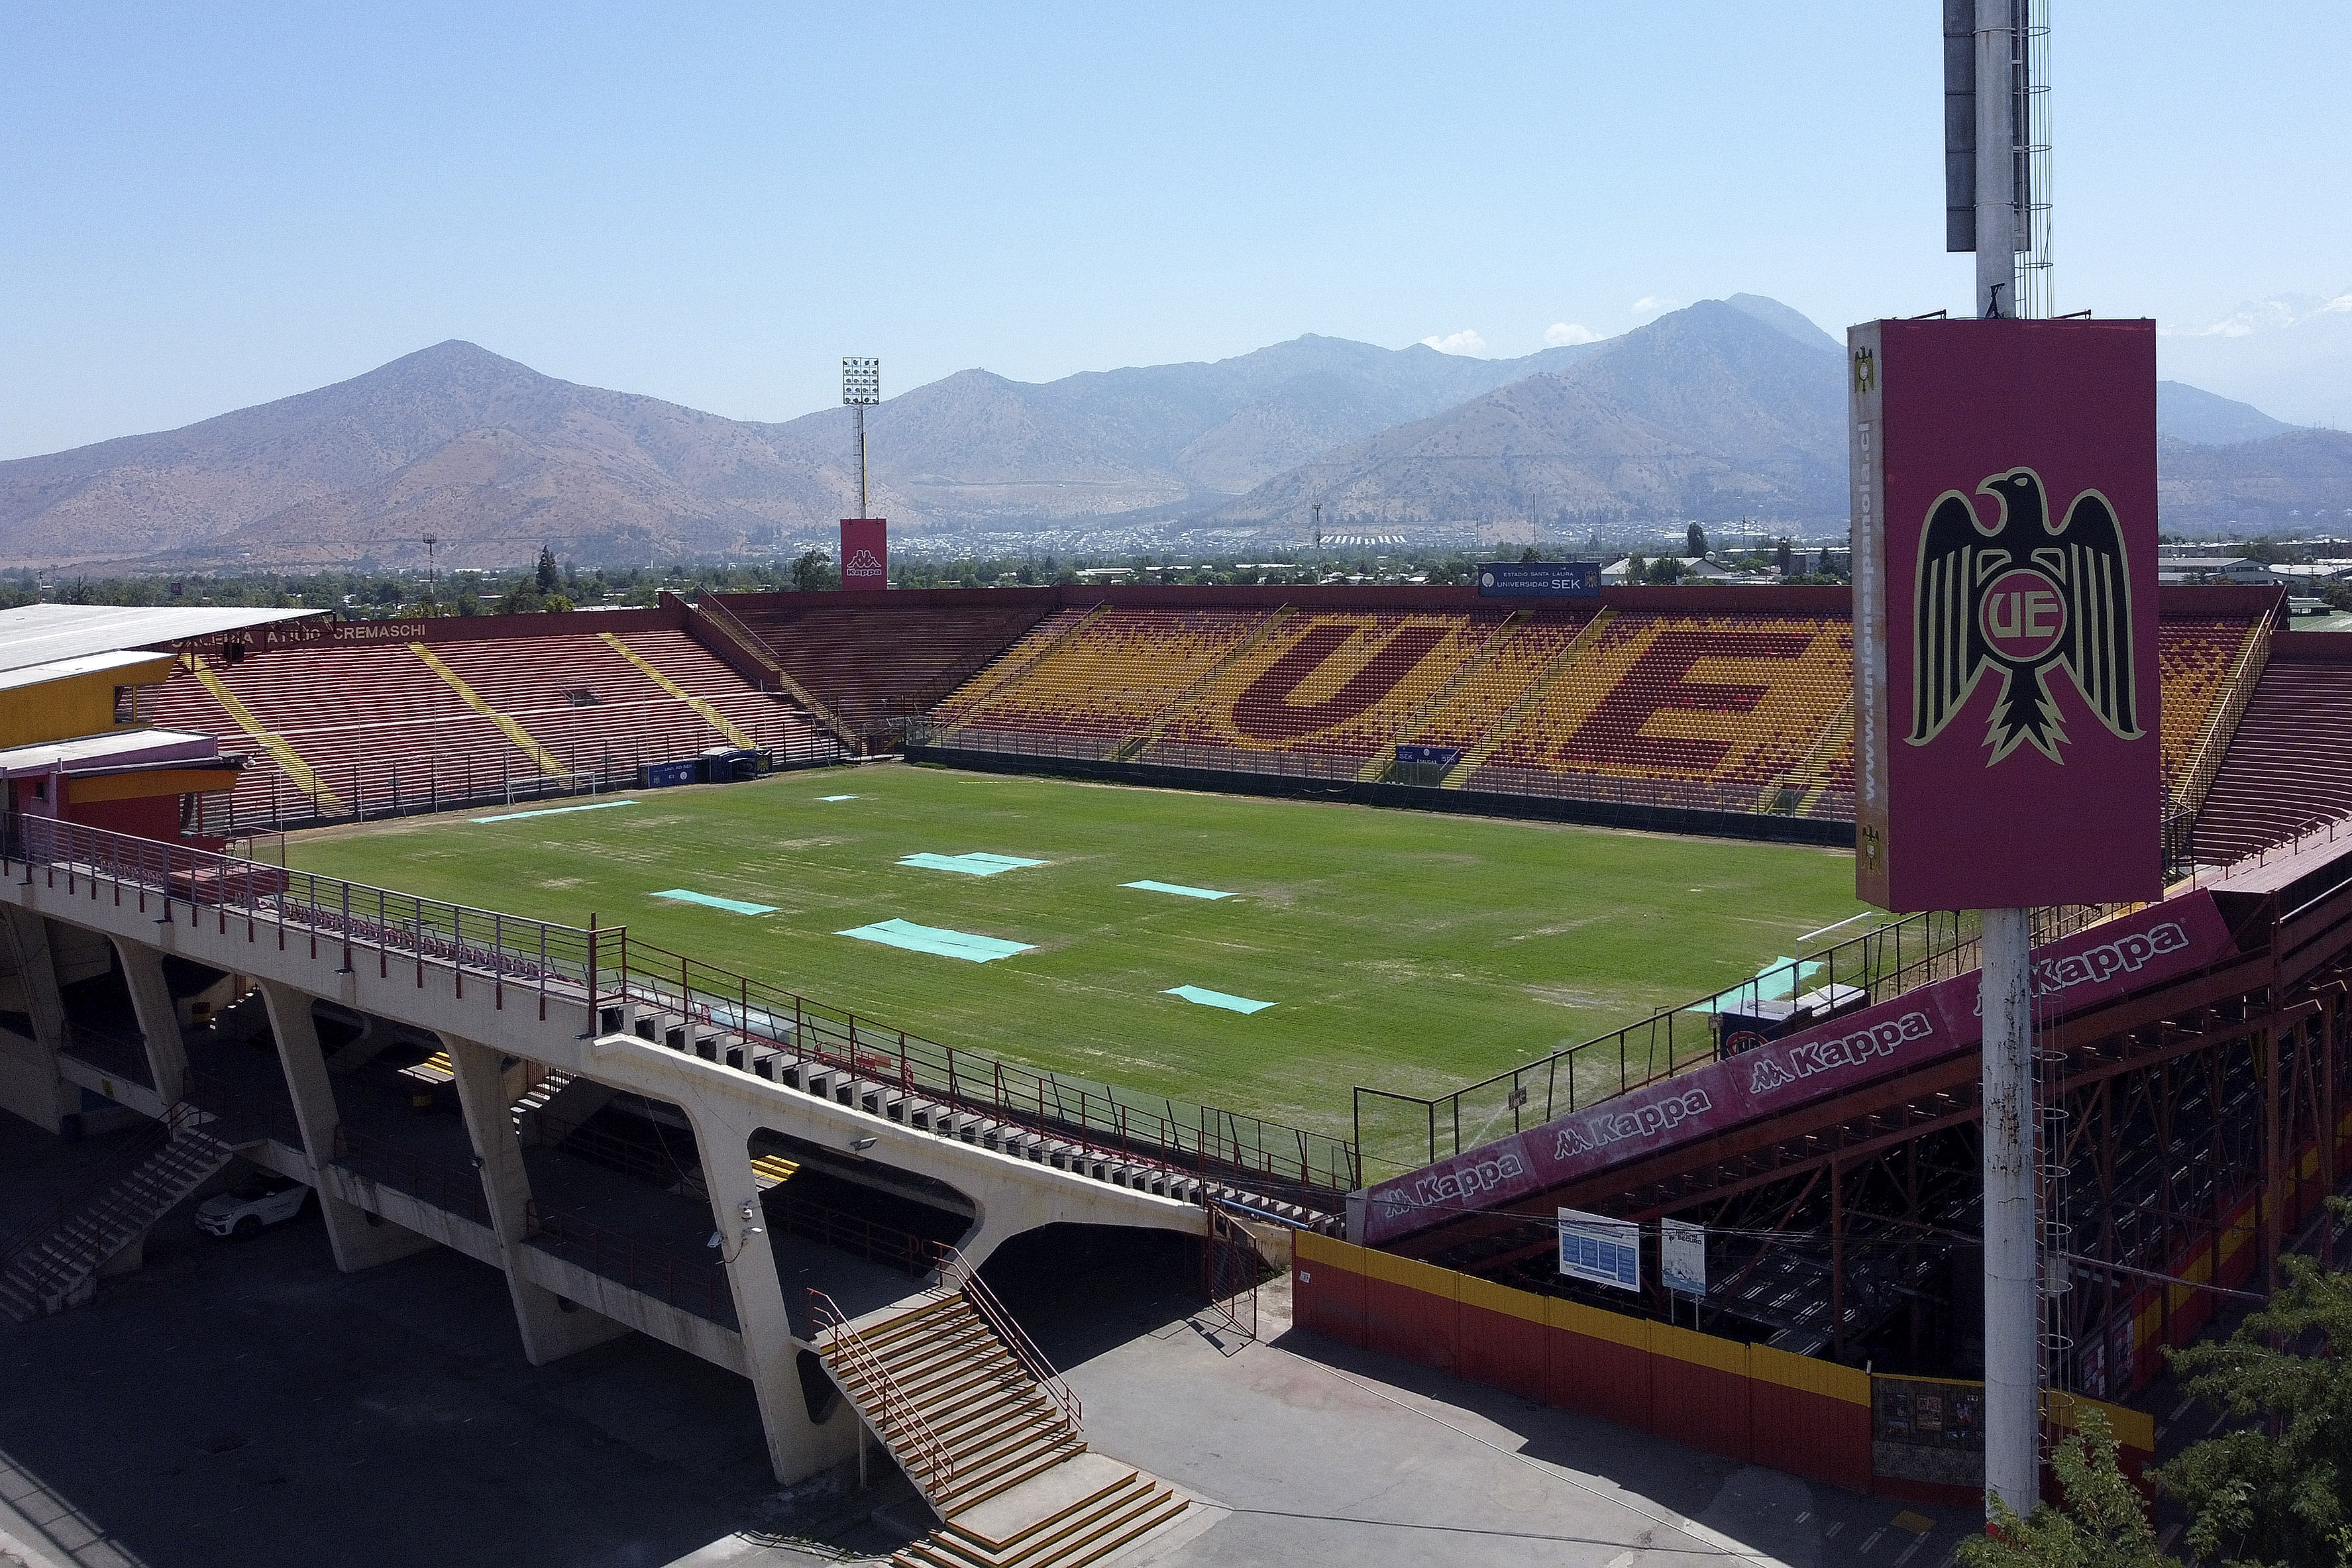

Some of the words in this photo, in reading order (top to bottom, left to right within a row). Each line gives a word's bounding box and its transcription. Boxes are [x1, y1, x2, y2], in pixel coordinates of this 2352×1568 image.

[1551, 580, 1581, 589] SEK
[333, 624, 426, 641] CREMASCHI
[1988, 591, 2059, 638] UE
[2029, 922, 2189, 995] Kappa
[1789, 1012, 1933, 1078] Kappa
[1595, 1088, 1713, 1147] Kappa
[1415, 1153, 1524, 1206] Kappa
